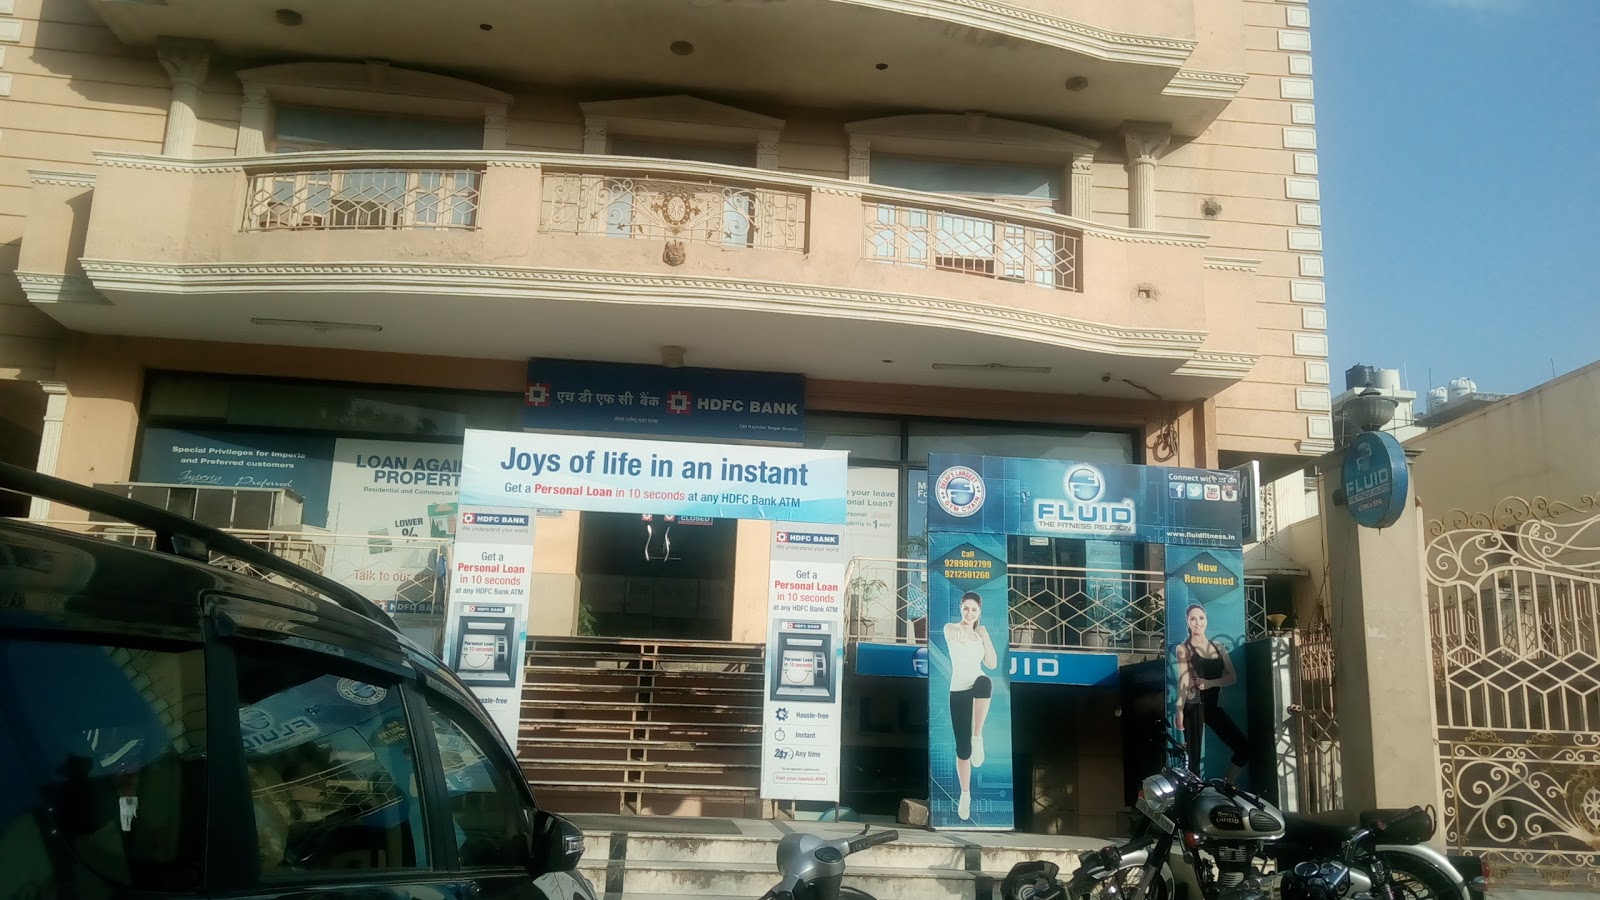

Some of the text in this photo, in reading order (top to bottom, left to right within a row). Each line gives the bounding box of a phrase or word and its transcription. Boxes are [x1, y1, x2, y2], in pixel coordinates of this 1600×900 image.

[557, 389, 661, 407] एच डी एफ सी बैंक
[697, 398, 798, 415] HDFC BANK
[172, 445, 305, 459] Special Privileges for Imperia
[200, 458, 244, 466] Preferred
[246, 461, 294, 469] customers
[356, 454, 407, 470] LOAN
[500, 447, 808, 486] Joys of life in an instant
[235, 476, 294, 490] Preferred
[374, 470, 461, 487] PROPERT
[940, 471, 978, 489] DELHI'S LARGEST
[1168, 473, 1199, 482] Connect
[1346, 467, 1389, 496] FLUID
[363, 486, 400, 494] Residential
[414, 488, 453, 496] Commercial
[504, 482, 800, 508] Get a Personal Loan in 10 seconds at any HDFC Bank ATM
[873, 489, 895, 497] leave
[945, 495, 980, 512] GYM CHAIN
[1038, 503, 1131, 523] FLUID
[395, 517, 424, 528] LOWER
[872, 519, 878, 529] 1
[1038, 520, 1055, 528] THE
[1057, 522, 1092, 530] FITNESS
[1166, 531, 1236, 540] www.fluidfitness.in
[481, 551, 496, 561] Get
[961, 550, 975, 558] Call
[457, 562, 525, 574] Personal Loan
[944, 559, 992, 568] 9289802799
[1197, 562, 1218, 572] Now
[354, 569, 376, 580] Talk
[379, 570, 390, 581] to
[393, 573, 411, 582] our
[796, 569, 810, 579] Get
[944, 570, 990, 579] 9212501260
[460, 574, 521, 586] in 10 seconds
[1184, 574, 1234, 586] Renovated
[774, 580, 838, 592] Personal Loan
[777, 592, 835, 603] in 10 seconds
[389, 602, 416, 611] HDFC
[796, 711, 829, 719] Hassle-free
[795, 731, 816, 739] Instant
[795, 750, 806, 758] Any
